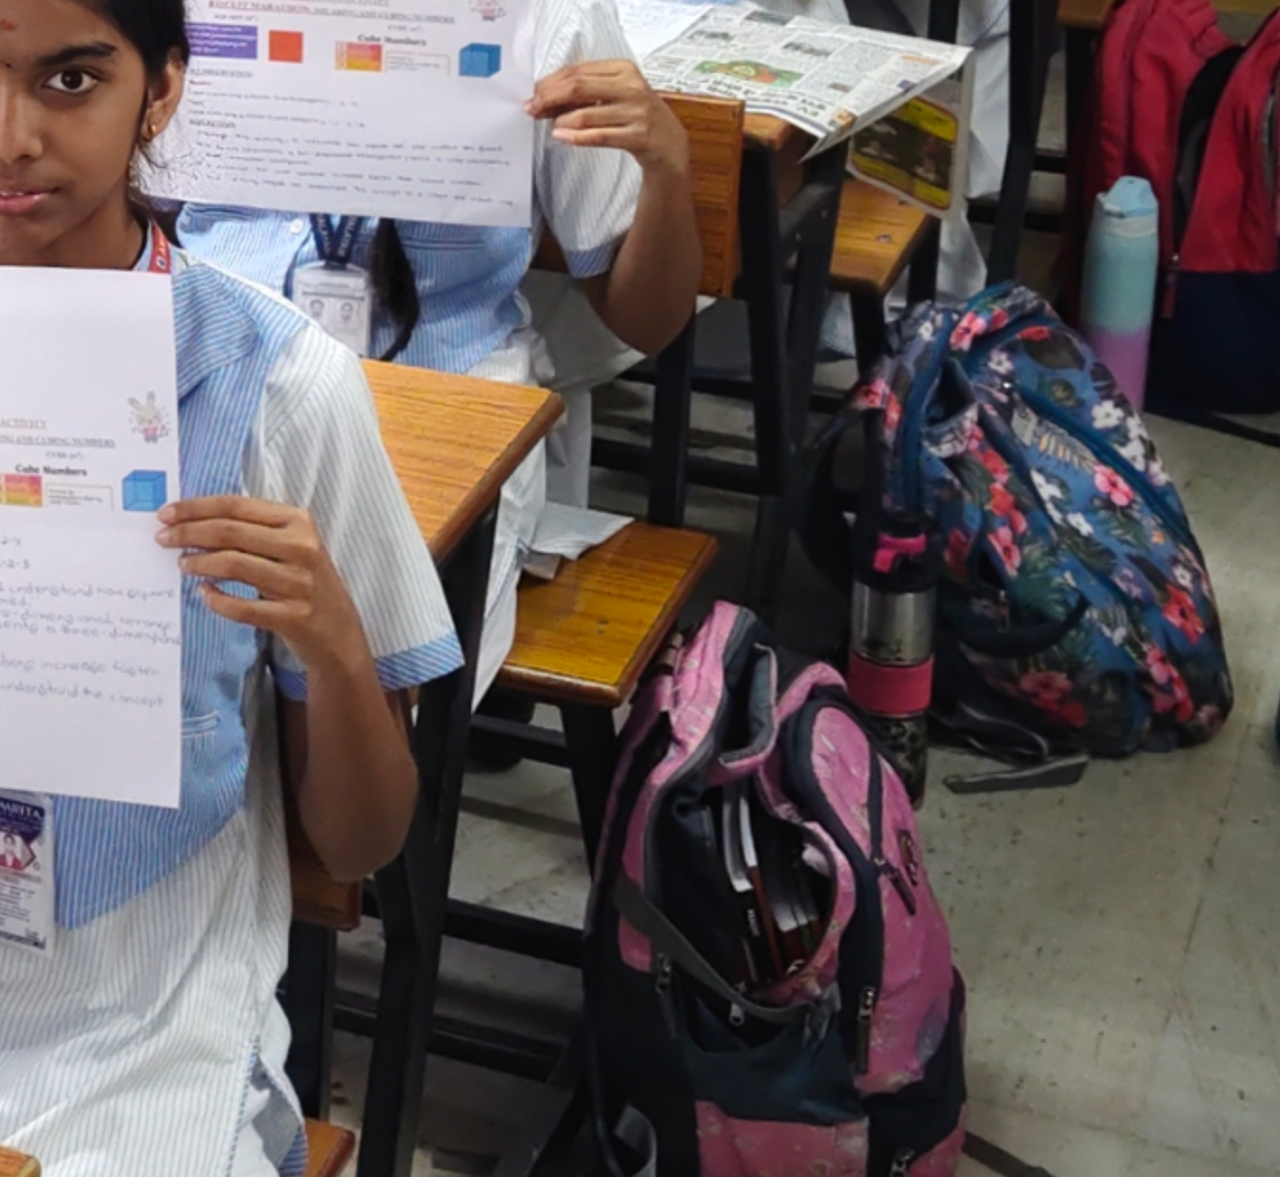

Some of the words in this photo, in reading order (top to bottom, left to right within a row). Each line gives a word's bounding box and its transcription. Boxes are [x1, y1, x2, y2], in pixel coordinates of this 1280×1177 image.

[357, 34, 382, 44] Cube
[384, 36, 427, 48] Numbers
[0, 417, 47, 429] ACTIVITY
[15, 463, 40, 474] Cube
[42, 466, 88, 477] Numbers
[0, 677, 80, 699] understand
[110, 693, 164, 709] concept
